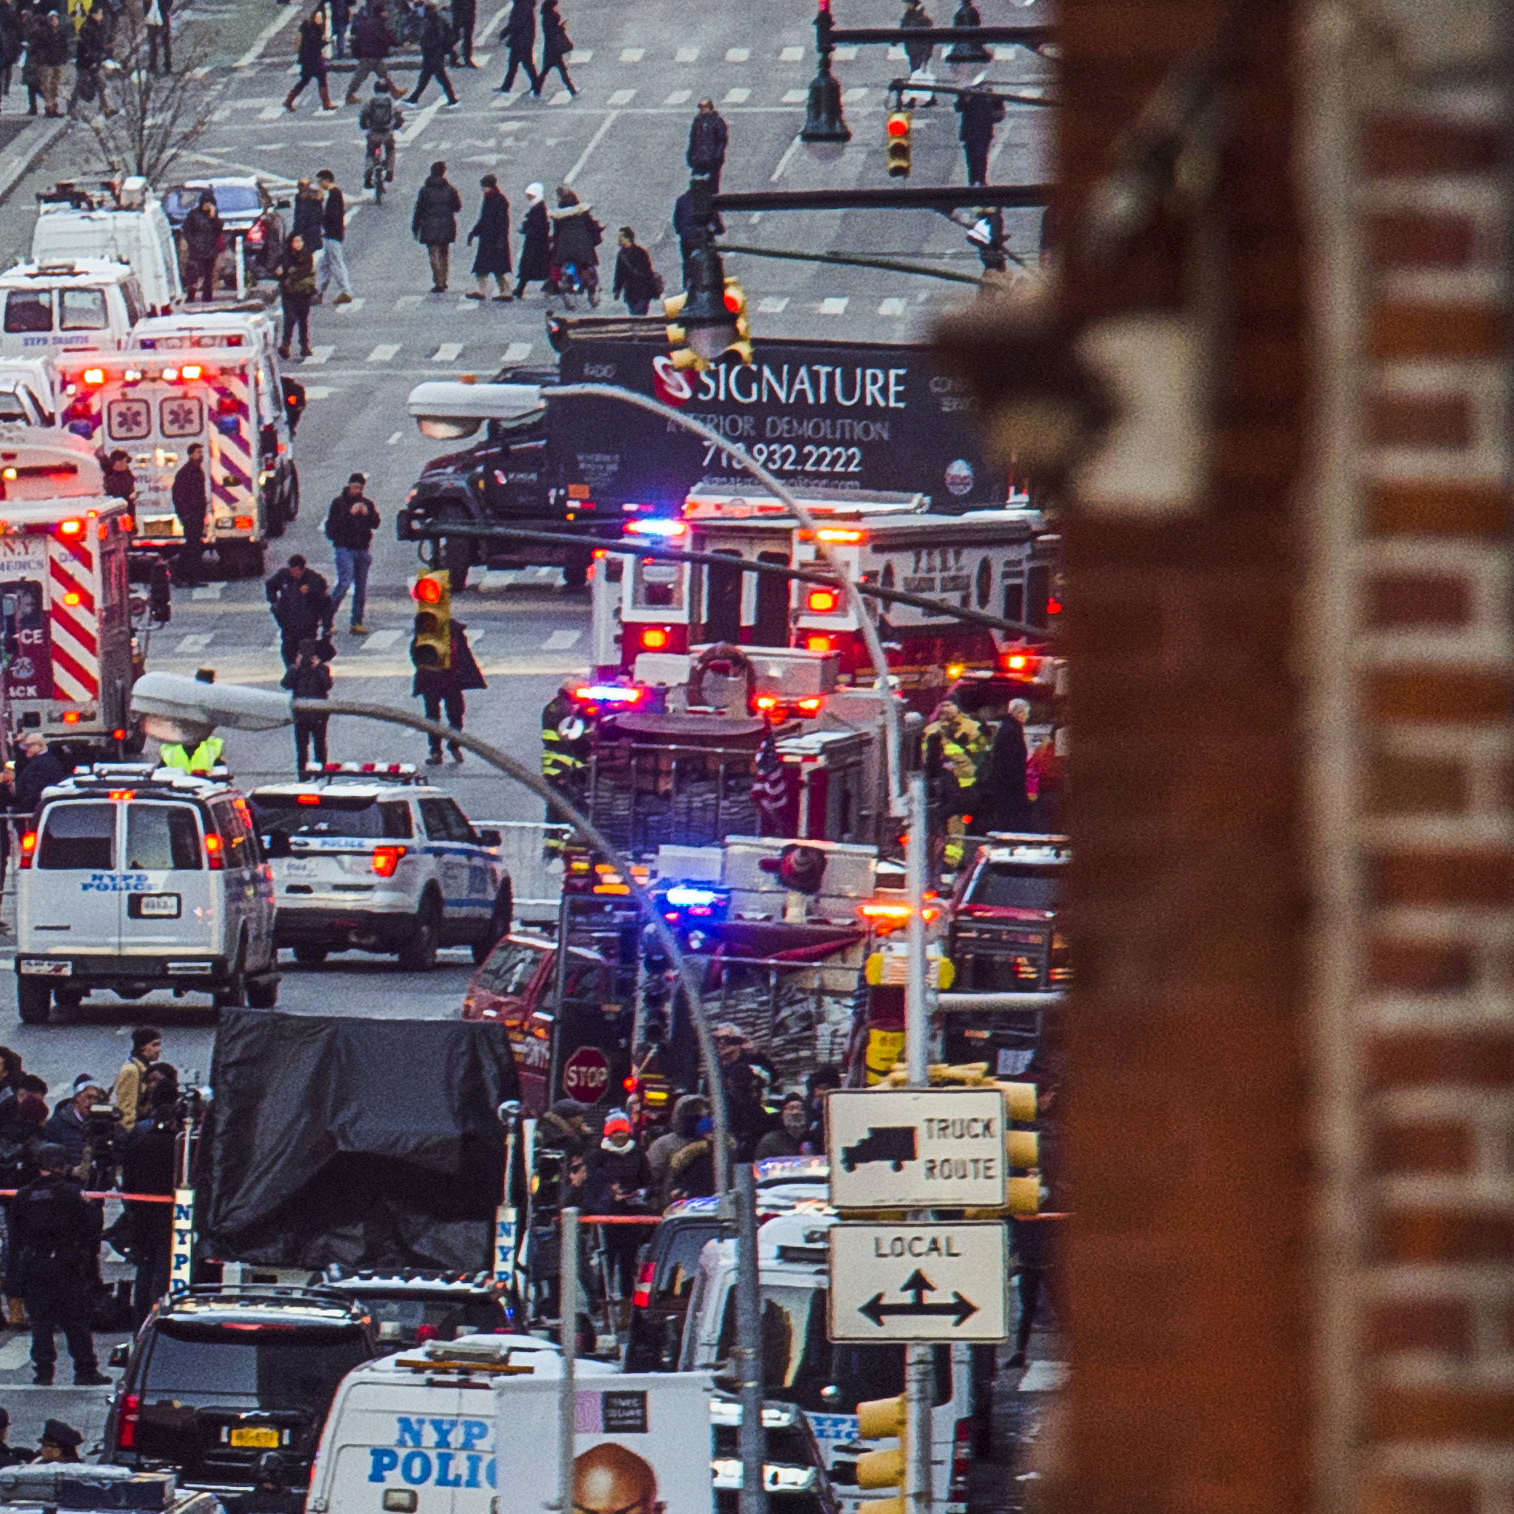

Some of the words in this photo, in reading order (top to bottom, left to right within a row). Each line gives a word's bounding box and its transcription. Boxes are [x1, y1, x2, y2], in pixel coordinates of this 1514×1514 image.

[696, 363, 908, 409] SIGNATURE
[765, 416, 891, 442] DEMOLITION
[80, 881, 157, 893] POLICE
[91, 873, 149, 884] NYPD
[566, 1065, 610, 1089] STOP
[923, 1117, 997, 1140] TRUCK
[923, 1158, 997, 1181] ROUTE
[495, 1220, 516, 1284] NYP
[873, 1236, 962, 1259] LOCAL
[395, 1416, 498, 1449] NYP
[367, 1448, 498, 1489] POLI
